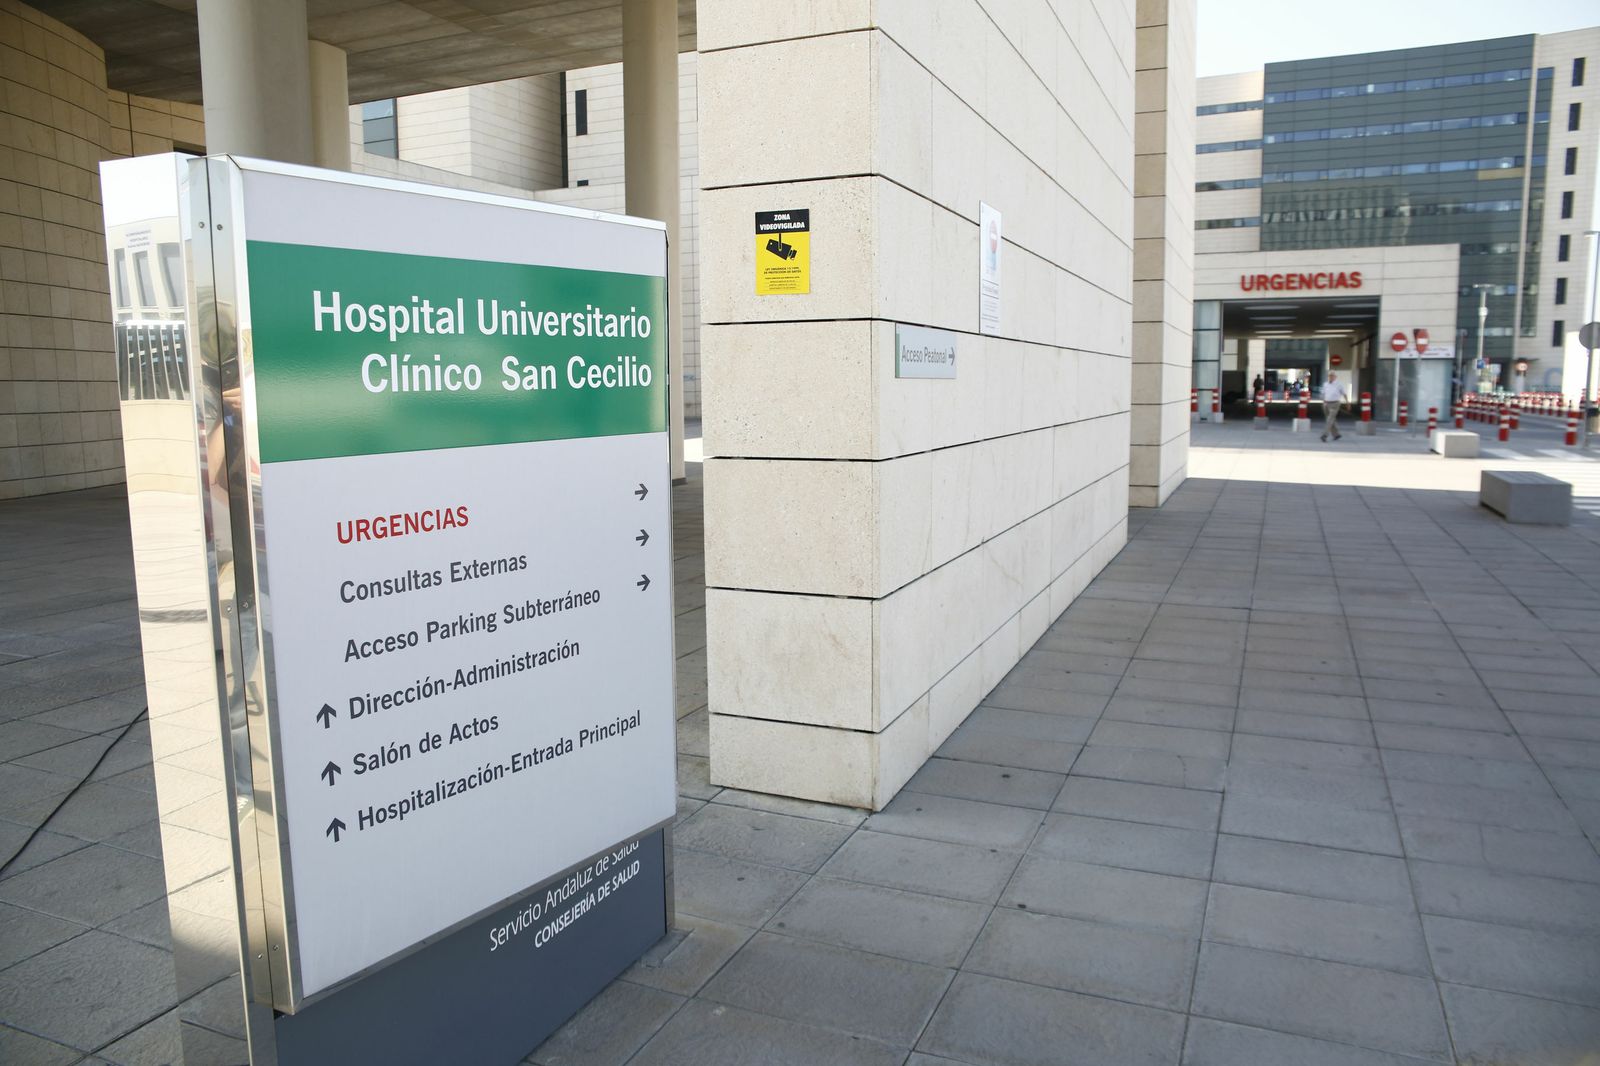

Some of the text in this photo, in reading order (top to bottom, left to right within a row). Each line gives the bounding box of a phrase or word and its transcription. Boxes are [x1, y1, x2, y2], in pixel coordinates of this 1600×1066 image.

[760, 221, 806, 231] VIDEOVIGILADA
[773, 213, 791, 221] ZONA
[1240, 271, 1362, 292] URGENCIAS
[312, 290, 651, 342] Hospital Universitario
[361, 353, 652, 393] Clínico San Cecilio
[901, 345, 923, 363] Acceso
[336, 506, 469, 544] URGENCIAS
[339, 554, 528, 604] Consultas Externas
[344, 588, 601, 662] Acceso Parking Subterráneo
[348, 639, 580, 720] Dirección-Administración
[352, 713, 500, 776] Salón de Actos
[357, 710, 642, 832] Hospitalización-Entrada Principal
[489, 903, 542, 952] Servicio
[544, 866, 593, 914] Andaluz
[595, 855, 610, 877] de
[534, 860, 640, 949] CONSEJERÍA DE SALUD
